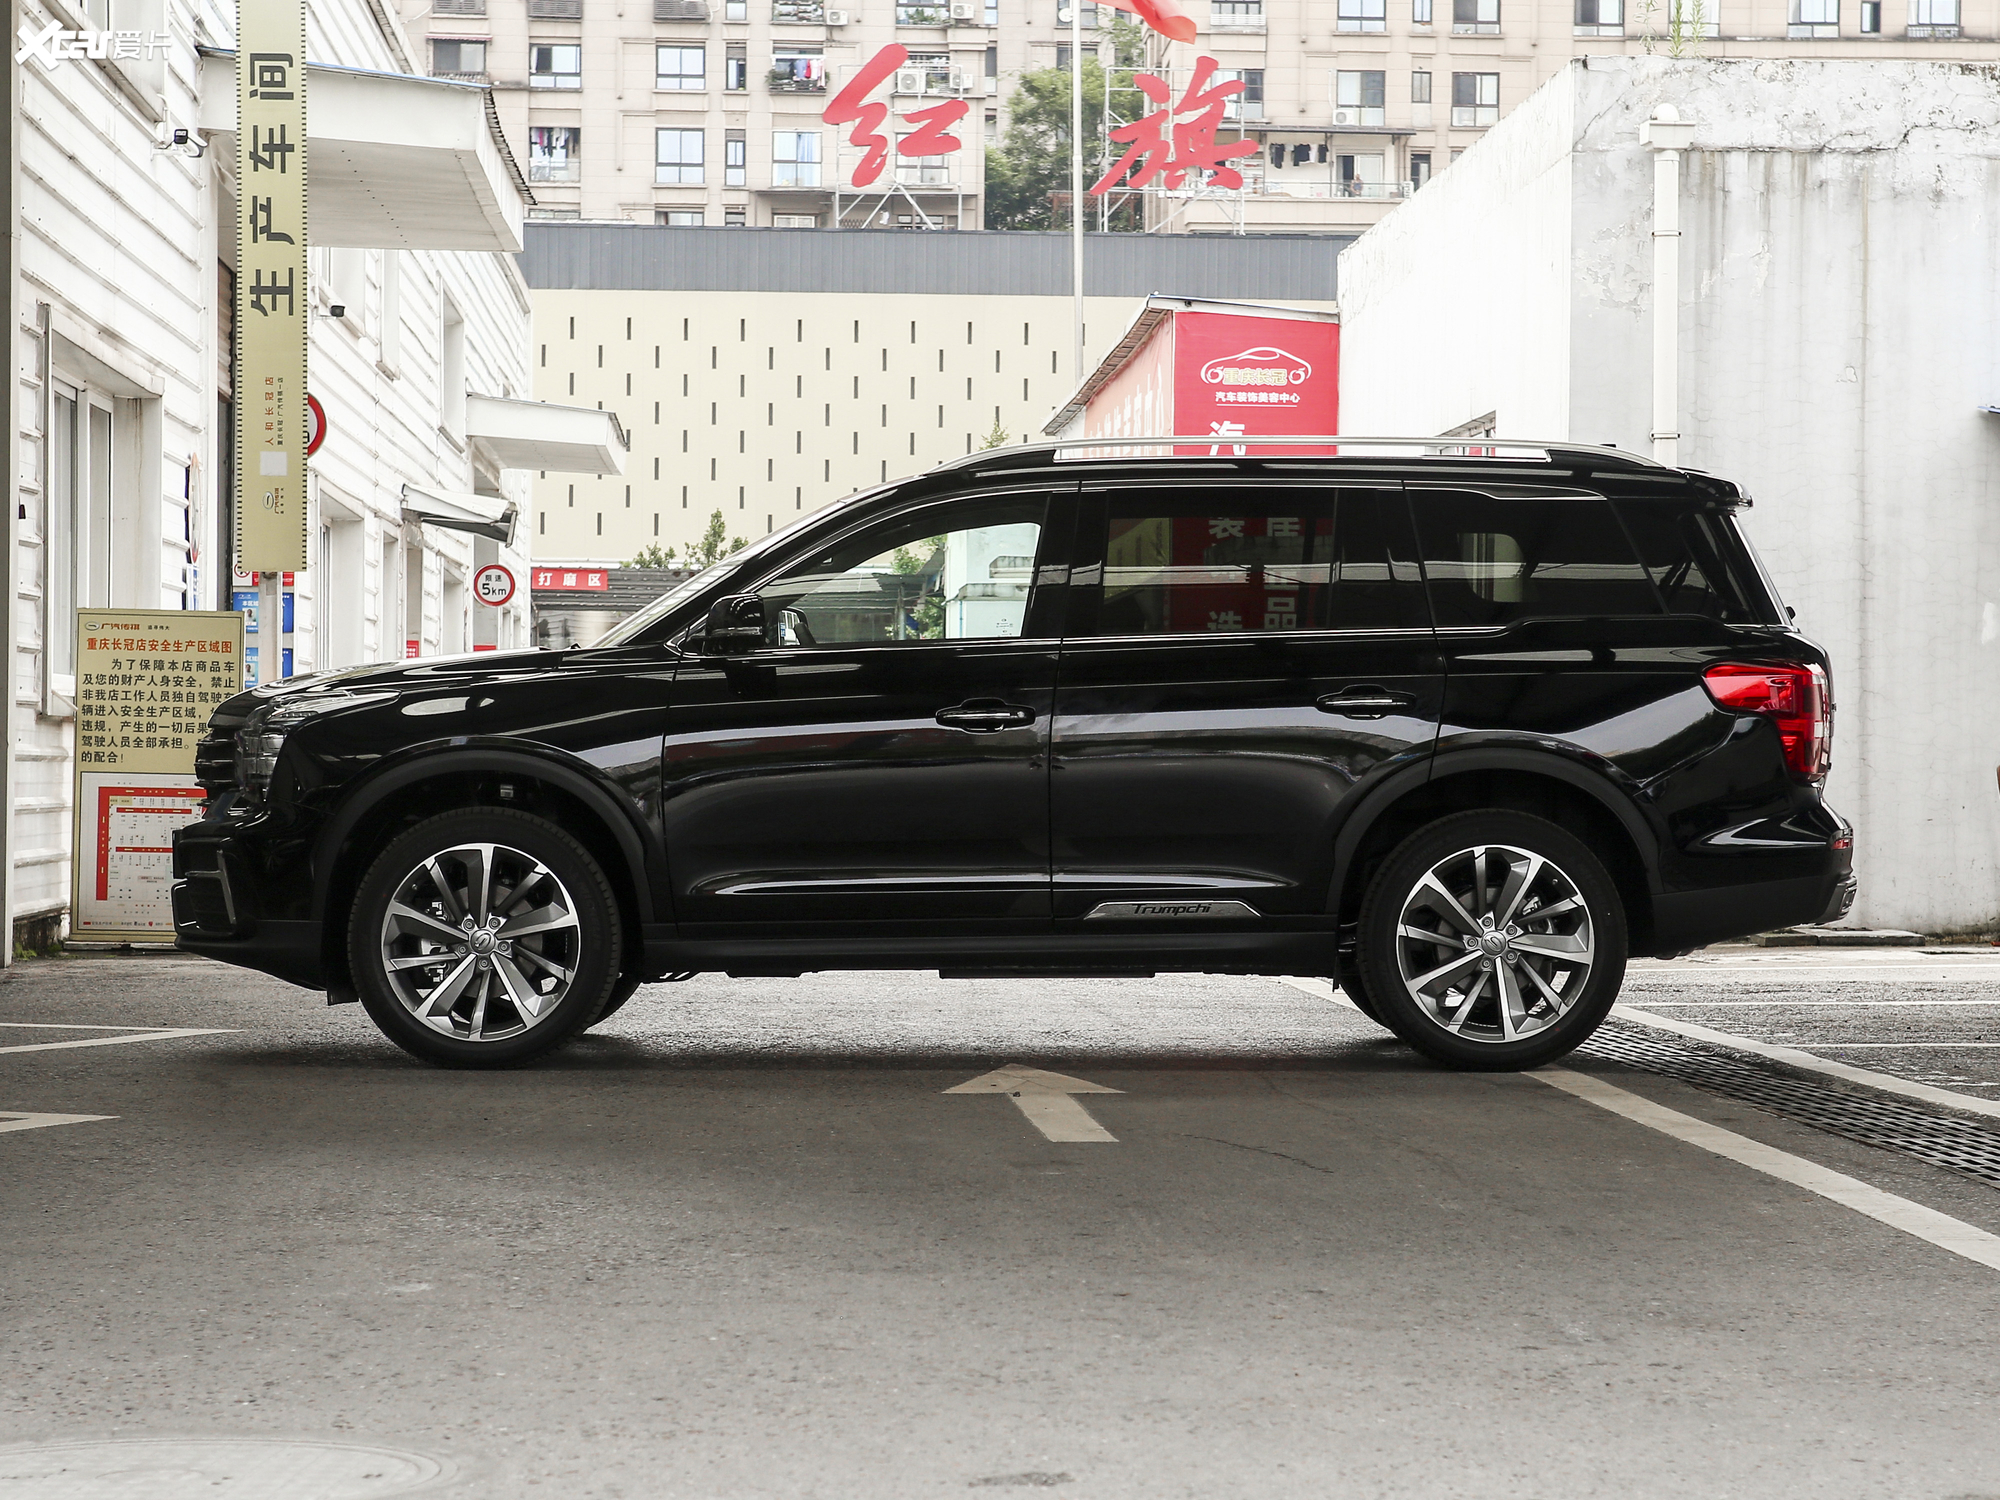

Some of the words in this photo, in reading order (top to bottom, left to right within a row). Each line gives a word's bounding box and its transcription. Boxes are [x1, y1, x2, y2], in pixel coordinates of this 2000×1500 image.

[249, 53, 295, 317] 生产车间
[1223, 367, 1287, 386] 重庆长冠
[1215, 391, 1301, 403] 汽车装饰美容中心
[265, 376, 274, 446] 人和长冠店
[485, 574, 502, 582] 限速
[538, 572, 602, 587] 打磨区
[482, 582, 507, 596] 5km
[87, 637, 232, 653] 重庆长冠店安全生产区域图
[112, 658, 235, 673] 为了保障本店商品车
[82, 673, 235, 689] 及您的财产人身安全，禁止
[81, 703, 215, 719] 辆进入安全生产区域，
[81, 719, 214, 735] 违规，产生的一切后果
[81, 735, 202, 749] 驾驶人员全部承担。
[1132, 903, 1212, 916] Trumpchi
